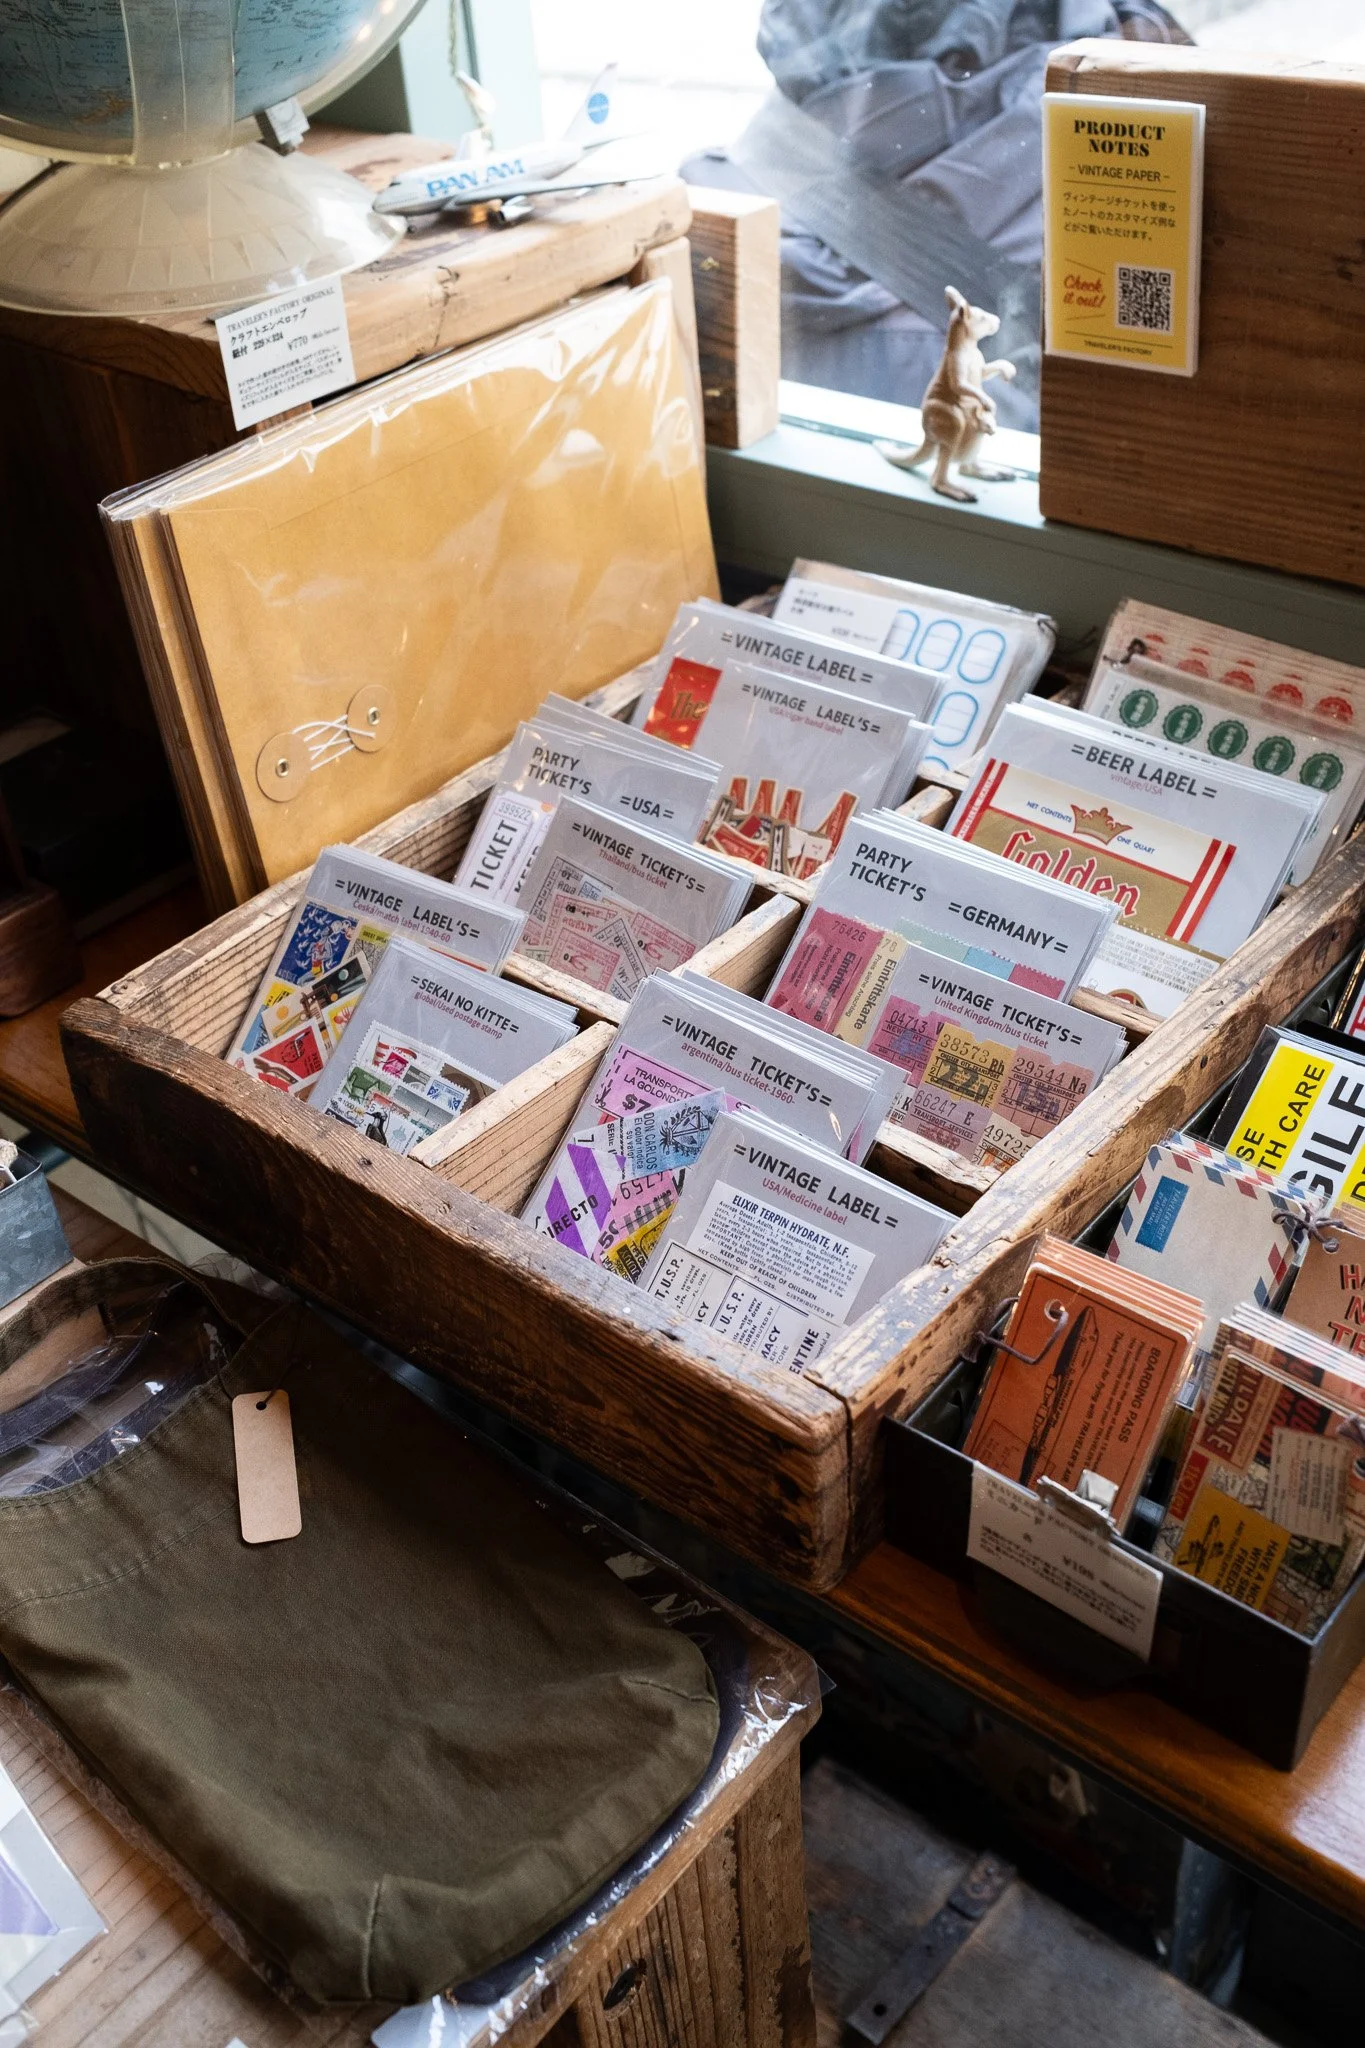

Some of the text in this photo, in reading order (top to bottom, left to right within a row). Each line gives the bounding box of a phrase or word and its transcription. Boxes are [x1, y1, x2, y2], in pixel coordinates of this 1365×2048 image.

[1074, 120, 1165, 140] PRODUCT
[1089, 139, 1149, 157] NOTES
[426, 160, 526, 197] PAN AM
[1078, 165, 1161, 182] VINTAGE PAPER
[1064, 274, 1102, 292] Check
[269, 300, 299, 317] FACTORY
[1064, 292, 1074, 305] it
[531, 746, 580, 771] PARTY
[526, 764, 592, 794] TICKET'S
[1026, 800, 1072, 823] NET CONTENTS
[468, 819, 519, 894] TICKET
[856, 844, 912, 873] PARTY
[1116, 835, 1155, 854] ONE QUART
[645, 873, 668, 889] ticket
[849, 862, 926, 901] TICKET'S
[400, 917, 420, 931] label
[830, 920, 866, 942] 76426
[453, 995, 474, 1012] NO
[852, 955, 897, 1033] Eintrittskarte
[452, 1010, 481, 1029] postage
[479, 1023, 503, 1040] stamp
[889, 1008, 928, 1034] 04713
[935, 996, 1048, 1049] United Kingdom/bus ticket
[681, 1042, 743, 1080] argentina/bus
[939, 1032, 991, 1064] 38573
[624, 1075, 637, 1089] LA
[1013, 1055, 1087, 1095] 29544 Na
[913, 1089, 957, 1117] 66247
[963, 1110, 974, 1126] E
[1278, 1064, 1326, 1132] CARE
[912, 1108, 946, 1127] TRANSPORT
[947, 1123, 974, 1139] SERVICES
[643, 1112, 657, 1170] DON CARLOS
[760, 1177, 848, 1225] USA/Medicine label
[731, 1194, 851, 1258] ELIXIR TERPIN HYDRATE, N.F.
[719, 1249, 817, 1300] KEEP OUT OF REACH OF CHILDREN
[1065, 1330, 1124, 1468] Thank you for flying with TRAVELER'S
[1117, 1346, 1162, 1443] BOARDING PASS
[1243, 1546, 1262, 1576] WITH
[1257, 1539, 1279, 1572] HAVE
[1254, 1572, 1265, 1582] A
